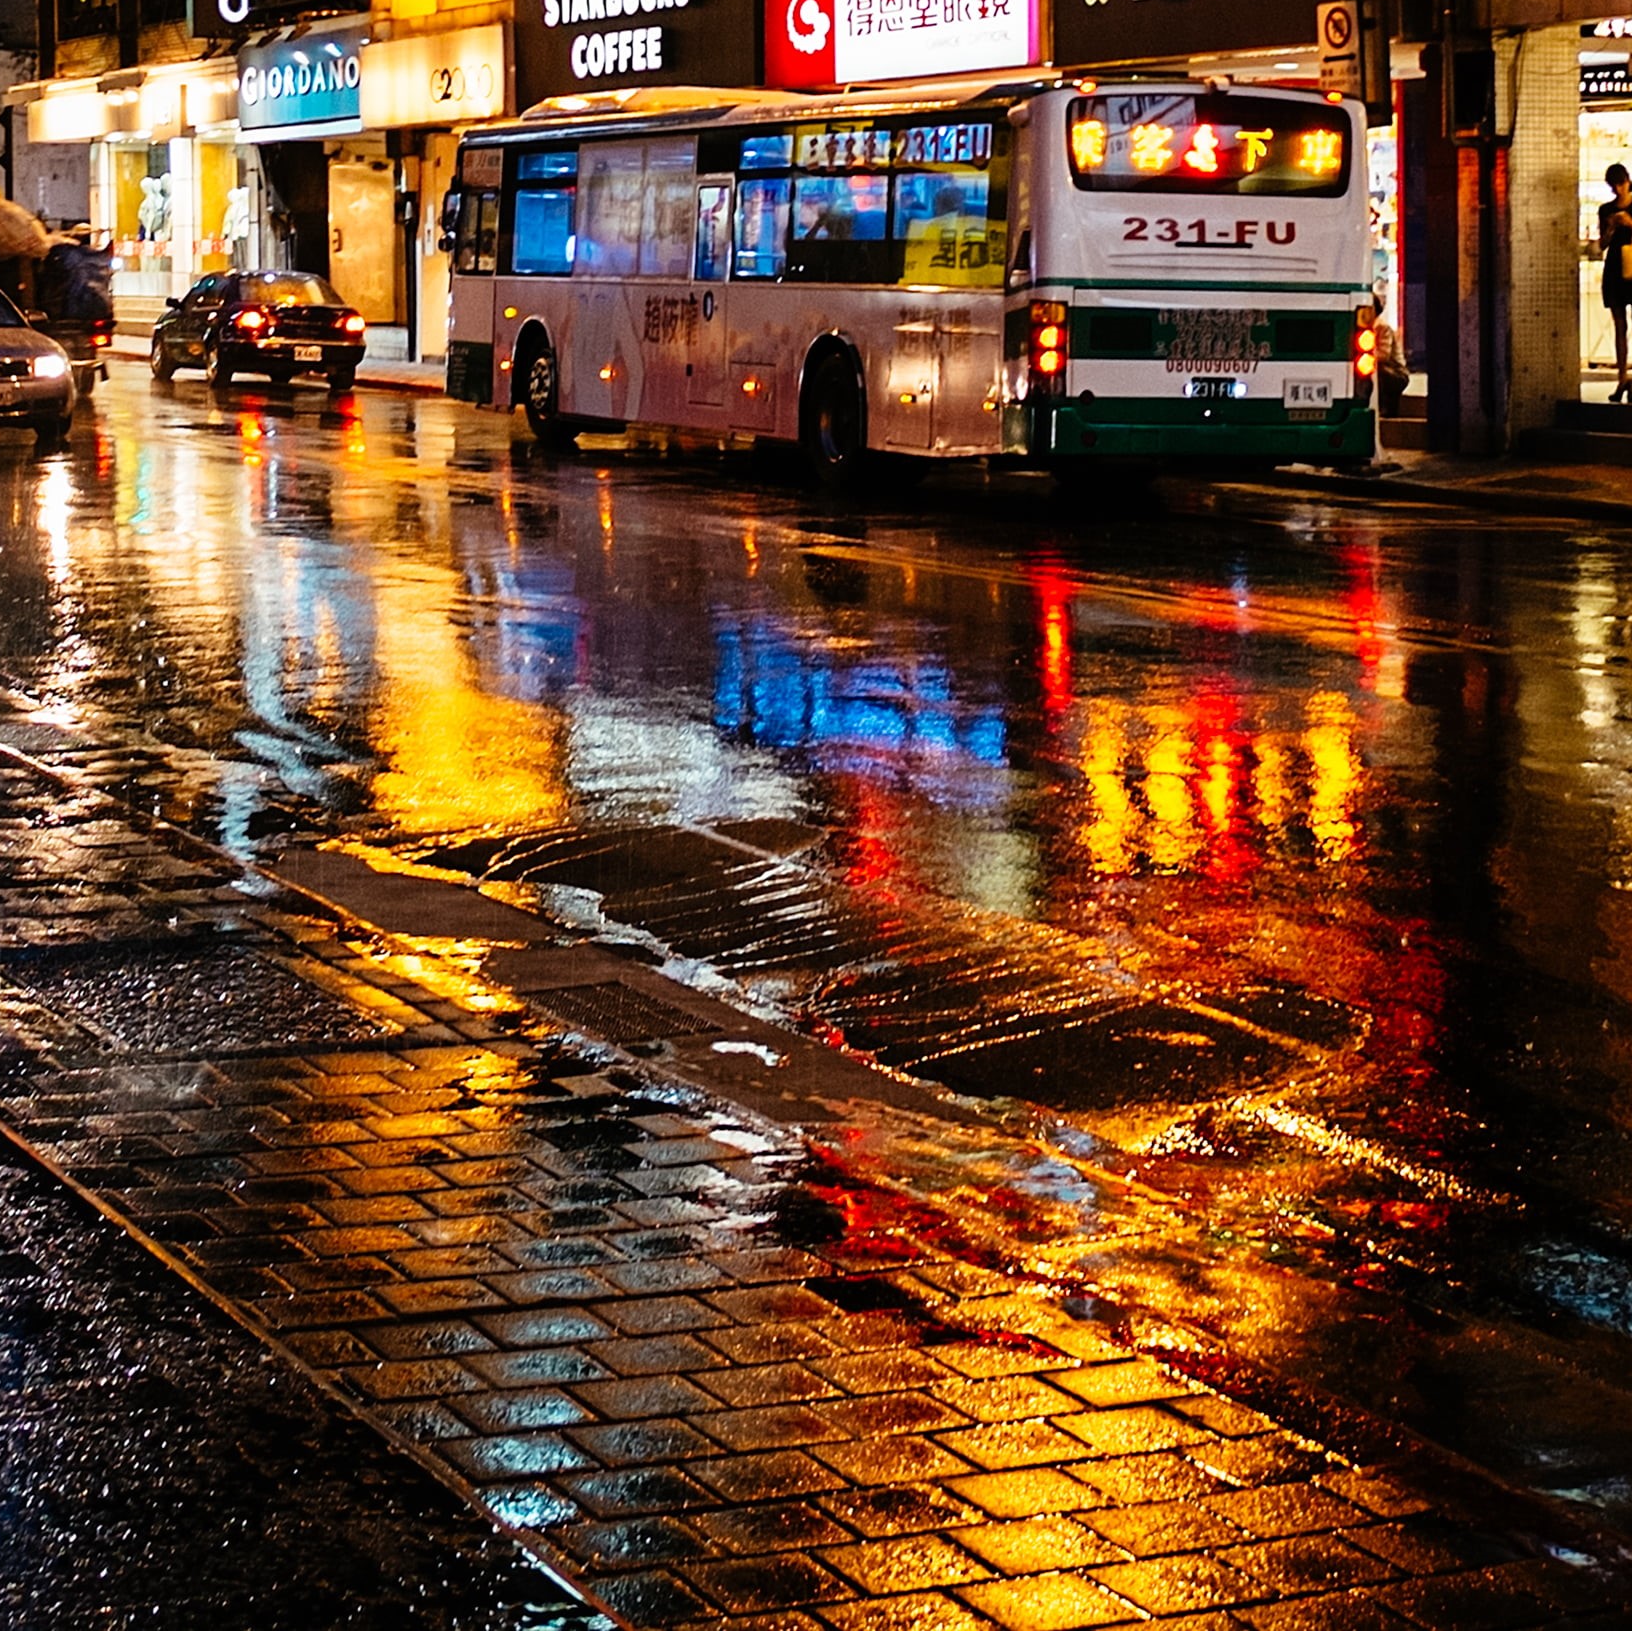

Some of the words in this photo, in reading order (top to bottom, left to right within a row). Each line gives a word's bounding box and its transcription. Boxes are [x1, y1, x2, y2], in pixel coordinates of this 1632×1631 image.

[570, 26, 663, 80] COFFEE
[240, 55, 361, 106] GIORDANO
[1122, 216, 1297, 246] 231-FU
